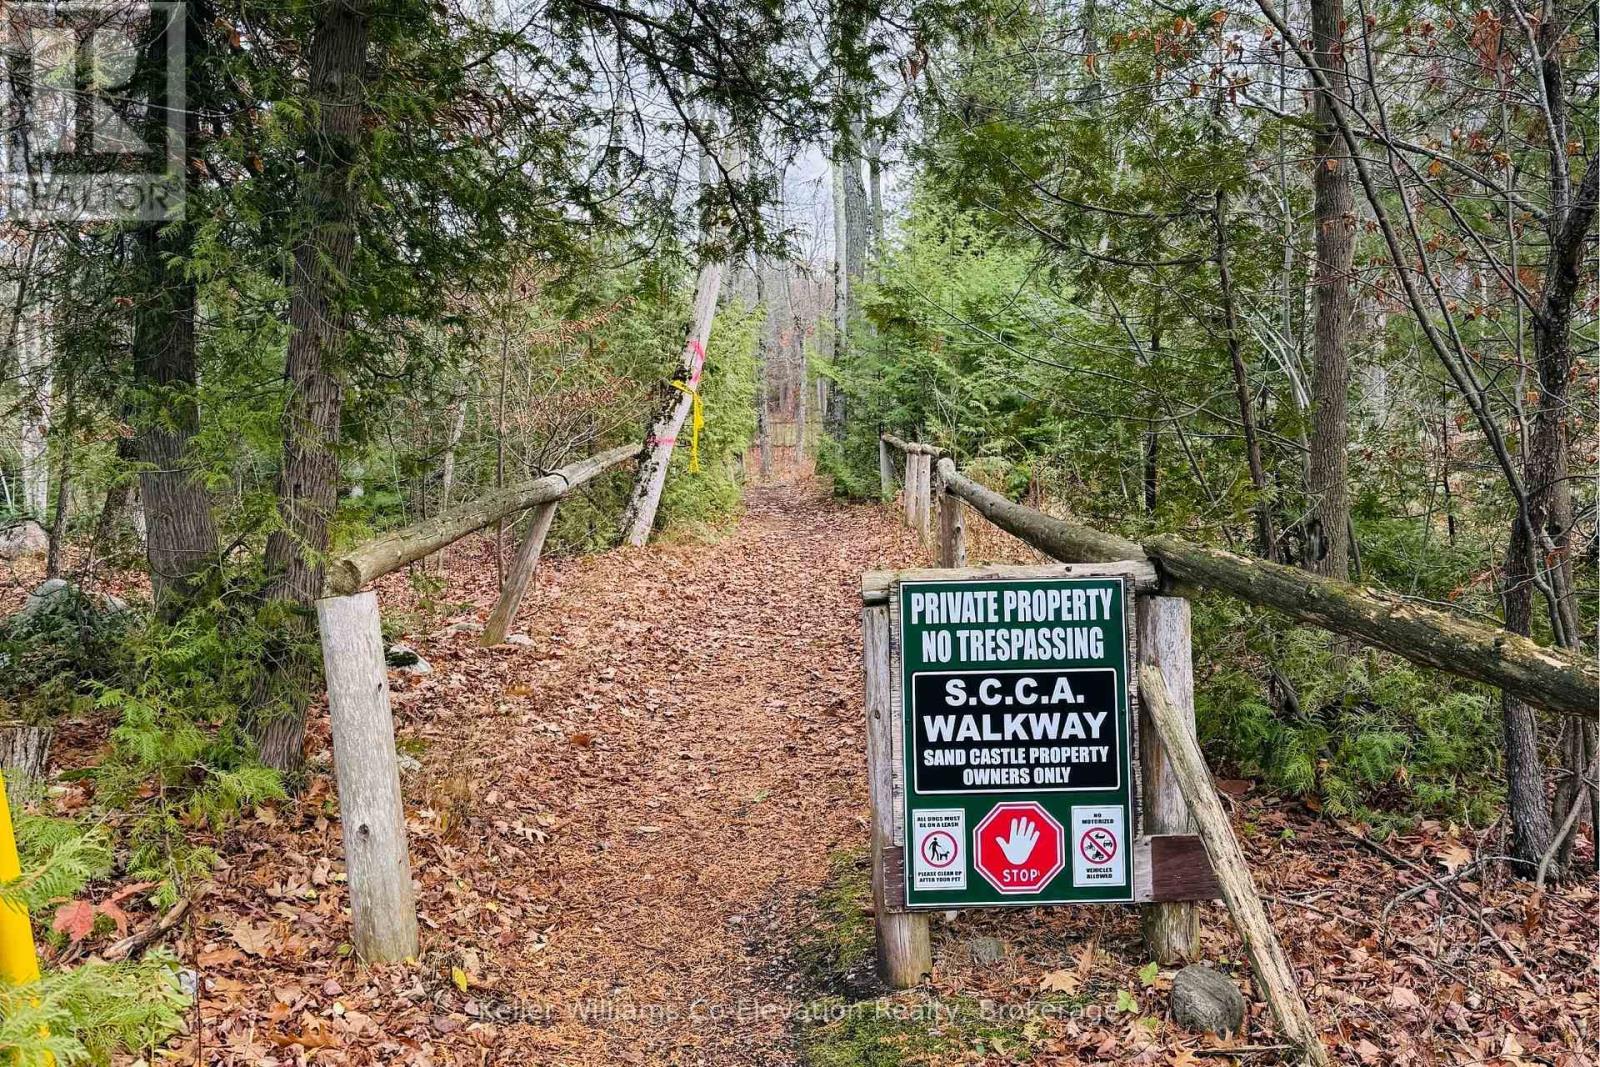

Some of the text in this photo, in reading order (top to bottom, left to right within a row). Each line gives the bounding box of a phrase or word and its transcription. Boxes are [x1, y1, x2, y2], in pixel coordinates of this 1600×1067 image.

[911, 588, 1113, 624] PRIVATE PROPERTY
[922, 627, 1104, 663] NO TRESPASSING
[945, 677, 1085, 706] S.C.C.A.
[923, 712, 1108, 742] WALKWAY
[924, 746, 1109, 766] SAND CASTLE PROPERTY
[963, 767, 1071, 785] OWNERS ONLY
[1003, 869, 1037, 882] STOP
